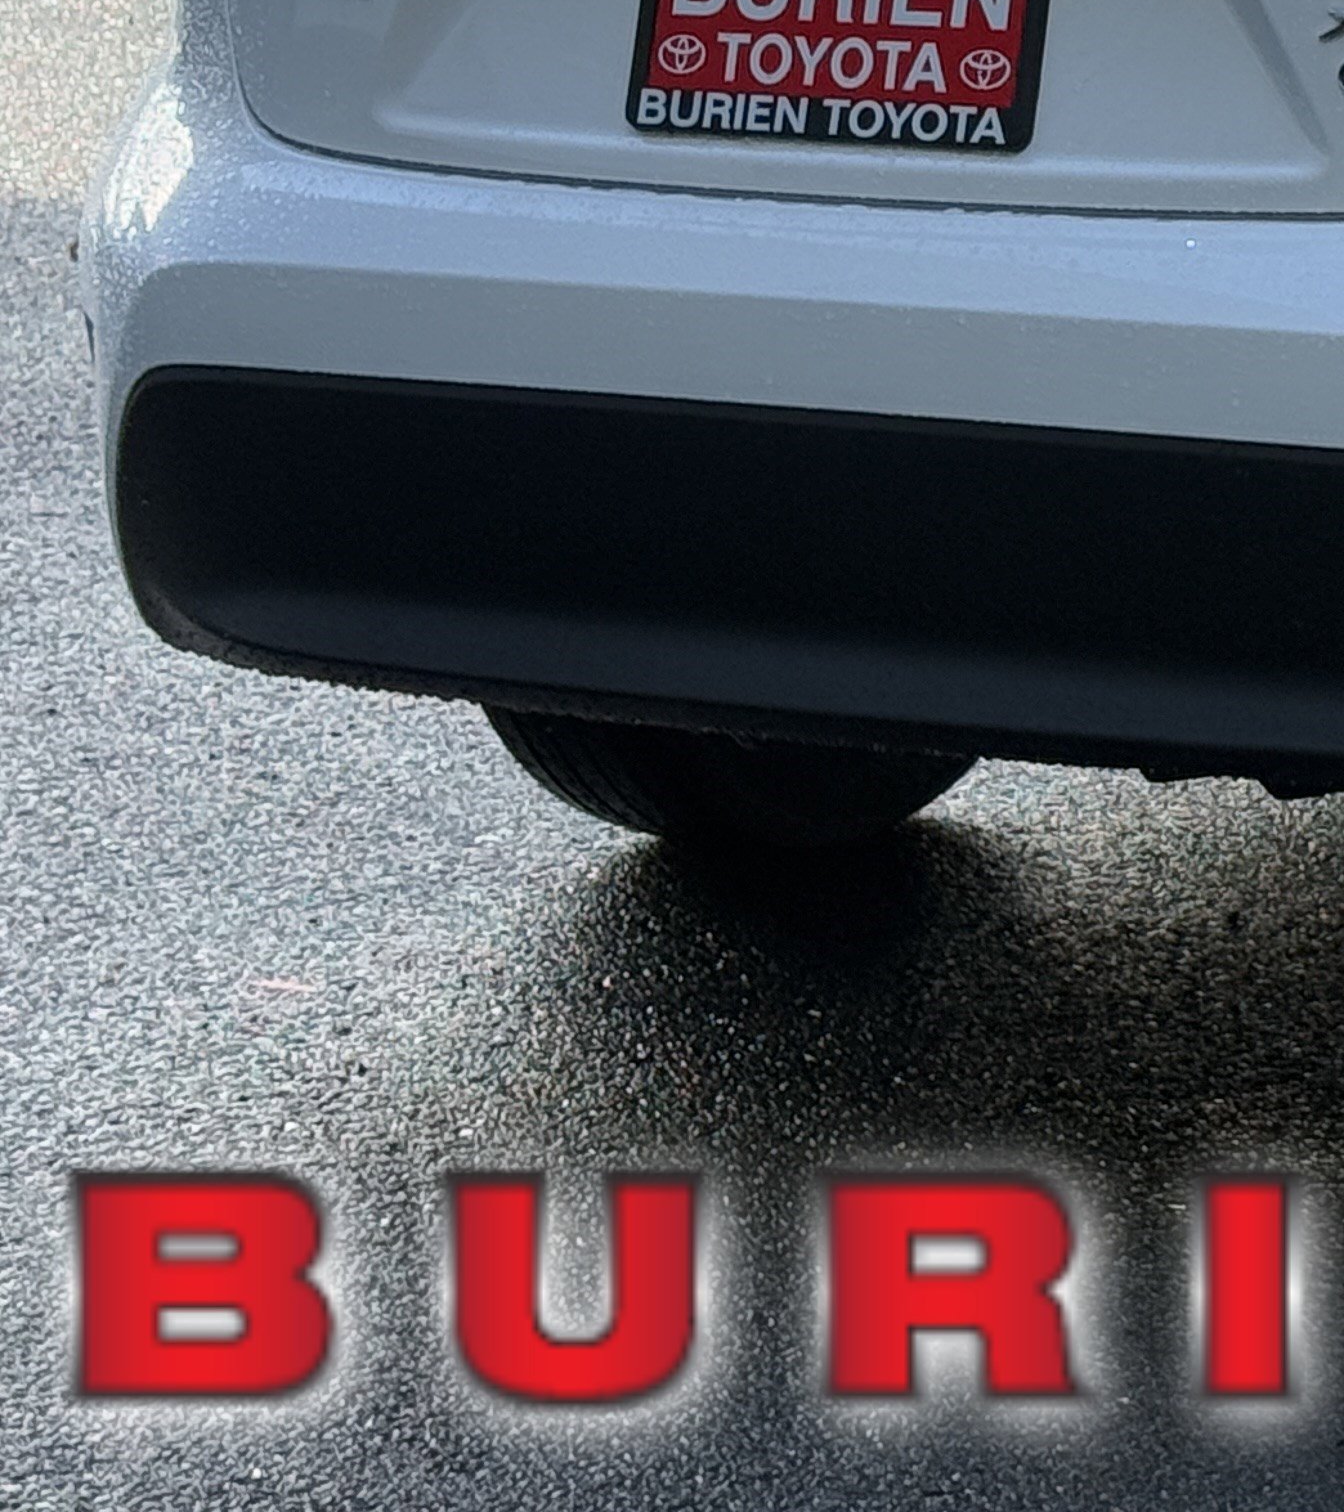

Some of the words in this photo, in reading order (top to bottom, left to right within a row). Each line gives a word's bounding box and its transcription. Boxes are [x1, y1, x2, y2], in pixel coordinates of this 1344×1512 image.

[716, 32, 947, 95] TOYOTA
[636, 87, 809, 135] BURIEN
[823, 98, 1007, 146] TOYOTA
